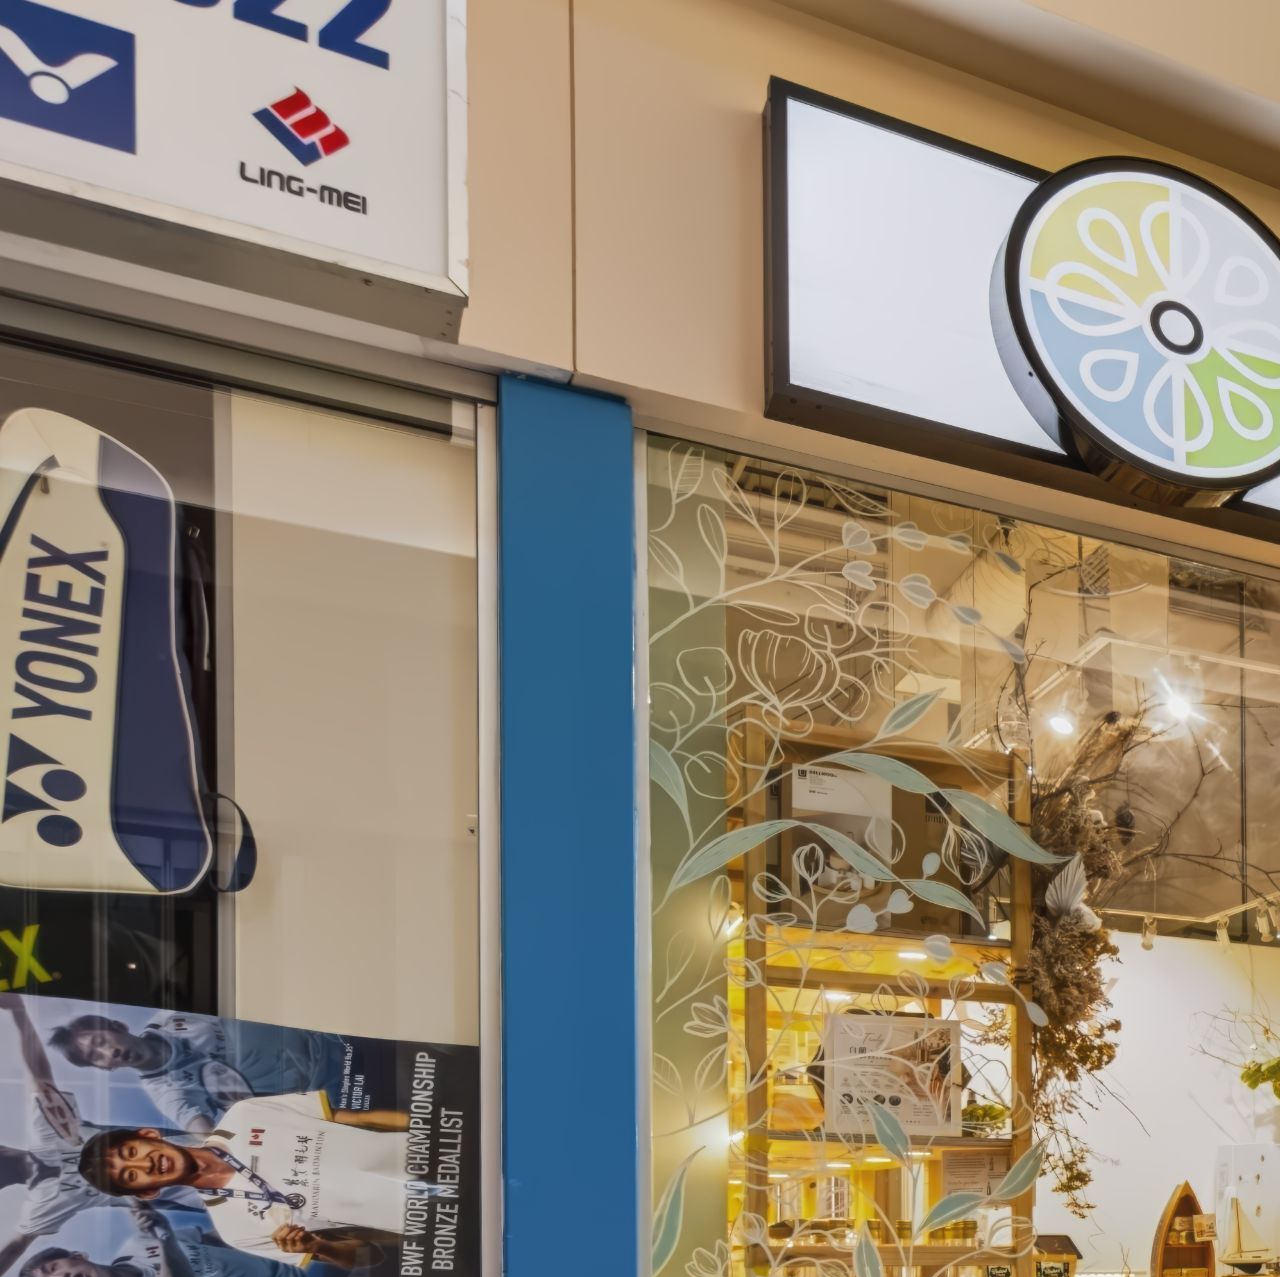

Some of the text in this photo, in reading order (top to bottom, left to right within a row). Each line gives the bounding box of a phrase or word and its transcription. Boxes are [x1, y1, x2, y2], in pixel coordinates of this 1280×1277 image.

[238, 161, 368, 215] LING-MEI
[10, 533, 110, 722] YONEX
[351, 1074, 365, 1110] VICTOR LAI
[407, 1051, 437, 1176] CHAMPIONSHIP
[405, 1180, 430, 1237] WORLD
[432, 1107, 464, 1271] BRONZE MEDALLIST
[401, 1240, 425, 1277] BWF
